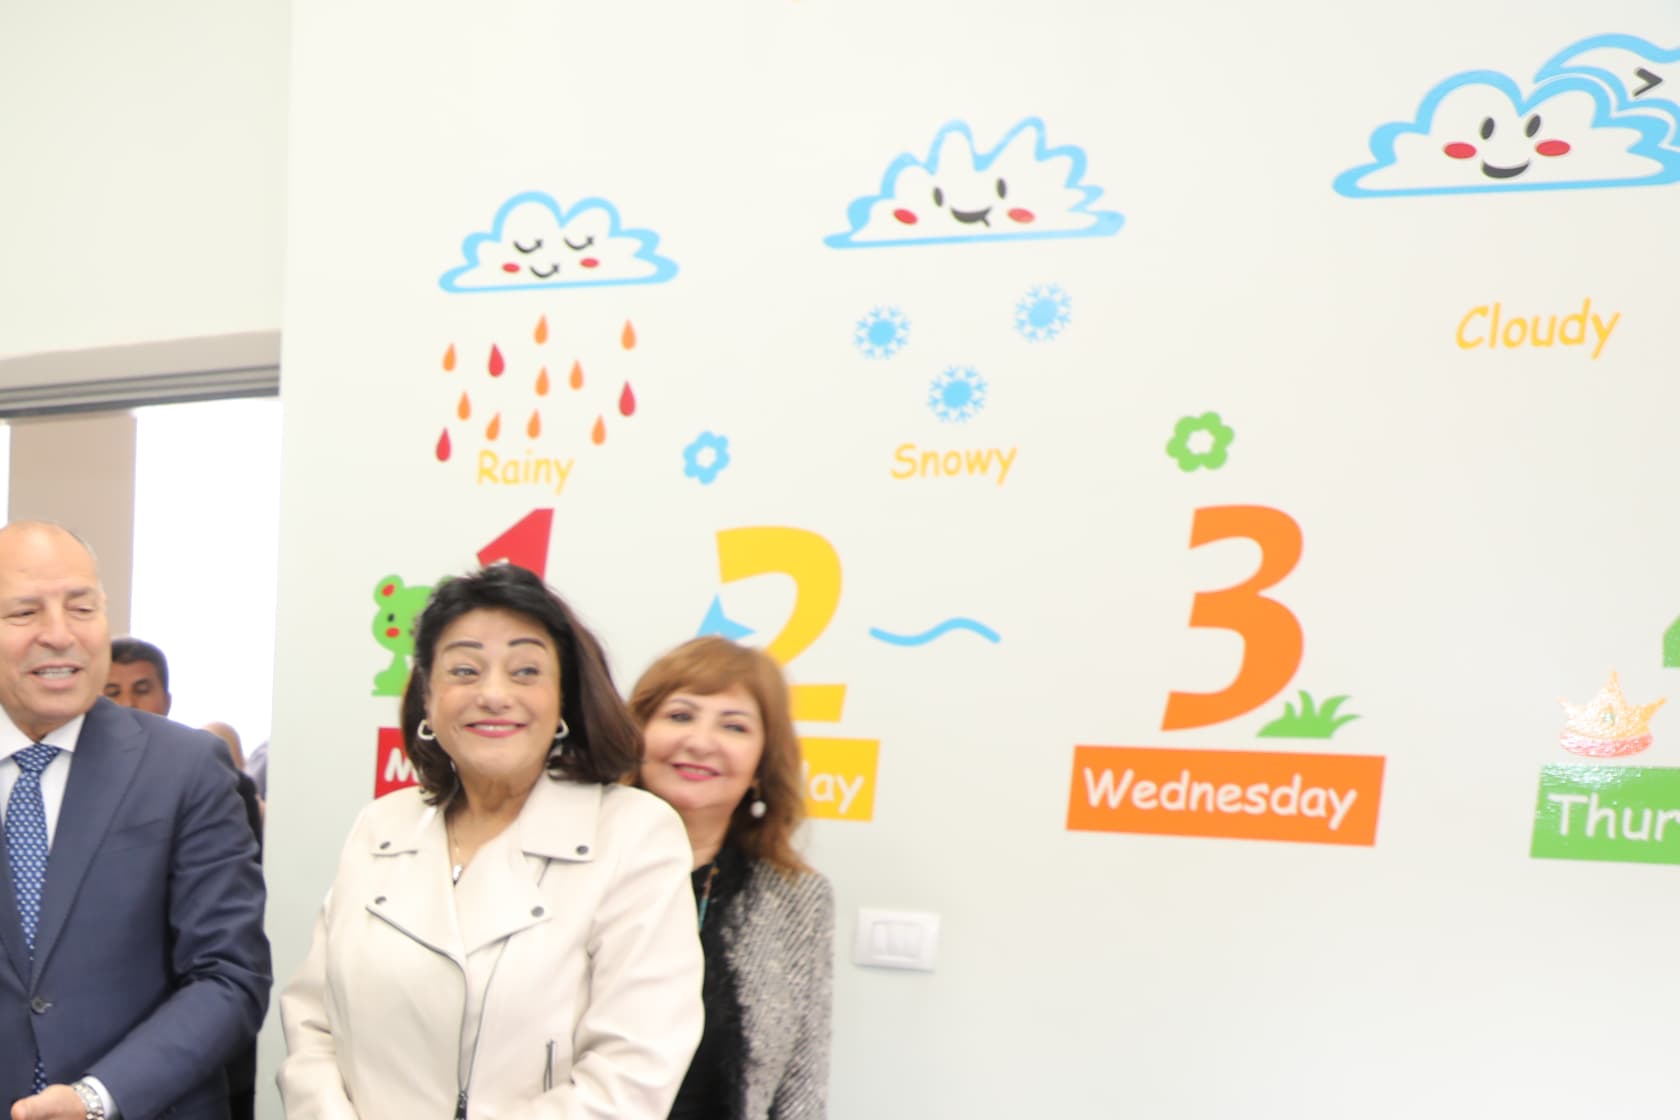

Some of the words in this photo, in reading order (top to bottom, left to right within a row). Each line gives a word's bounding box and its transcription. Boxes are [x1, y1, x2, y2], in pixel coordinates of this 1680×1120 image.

[1455, 297, 1621, 361] Cloudy
[477, 448, 575, 495] Rainy
[890, 443, 1019, 487] Snowy
[715, 525, 846, 722] 2
[1160, 504, 1304, 732] 3
[1083, 767, 1358, 831] Wednesday
